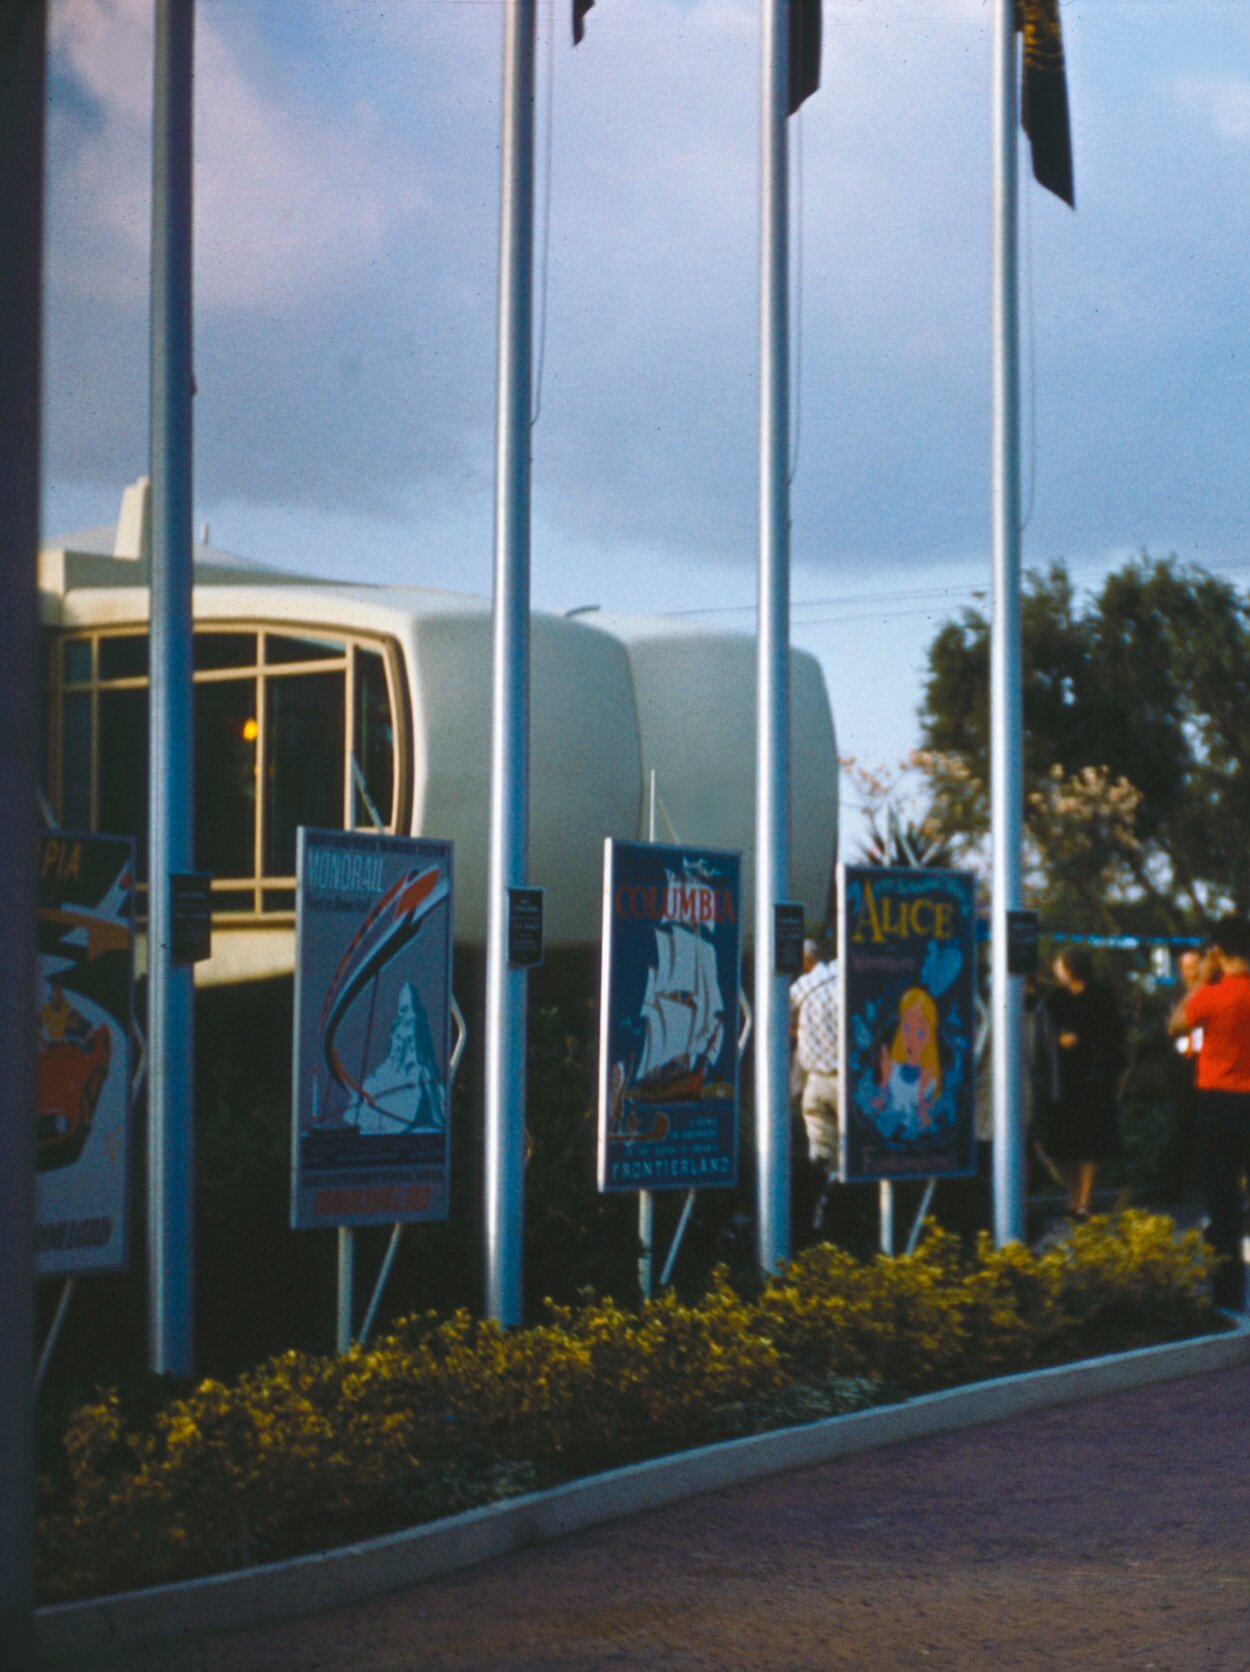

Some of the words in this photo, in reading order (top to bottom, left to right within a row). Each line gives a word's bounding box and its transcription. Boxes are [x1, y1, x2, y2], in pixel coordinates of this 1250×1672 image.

[307, 849, 384, 894] MONORAIL
[614, 883, 737, 925] COLUMBIA
[611, 1156, 730, 1180] FRONTIERLAND
